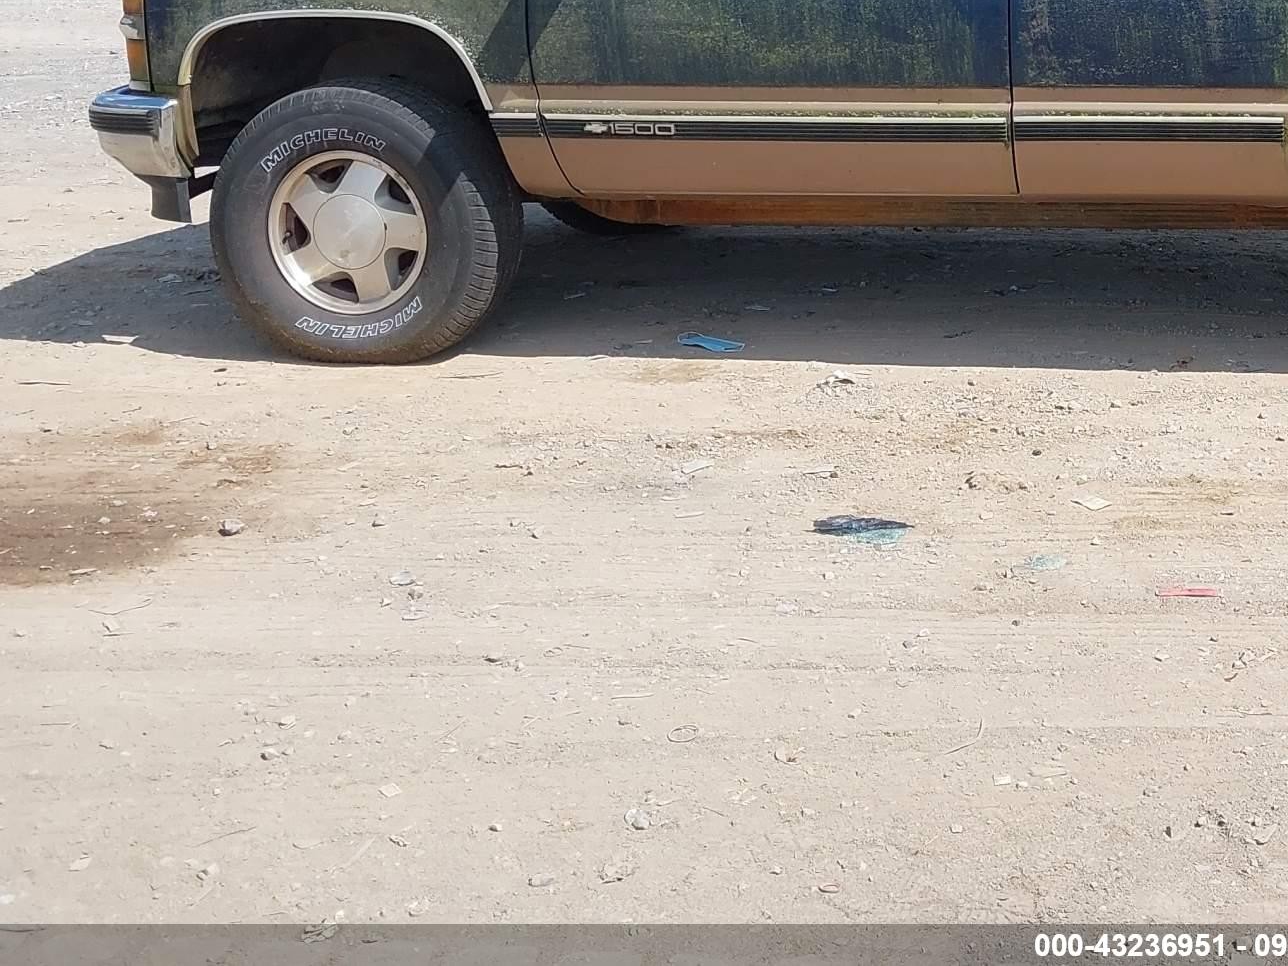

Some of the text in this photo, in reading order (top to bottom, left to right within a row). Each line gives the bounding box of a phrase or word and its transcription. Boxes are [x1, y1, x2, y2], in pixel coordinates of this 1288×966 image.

[609, 122, 675, 136] 1500
[260, 128, 387, 174] MICHELIN
[295, 296, 423, 339] MICHELIN
